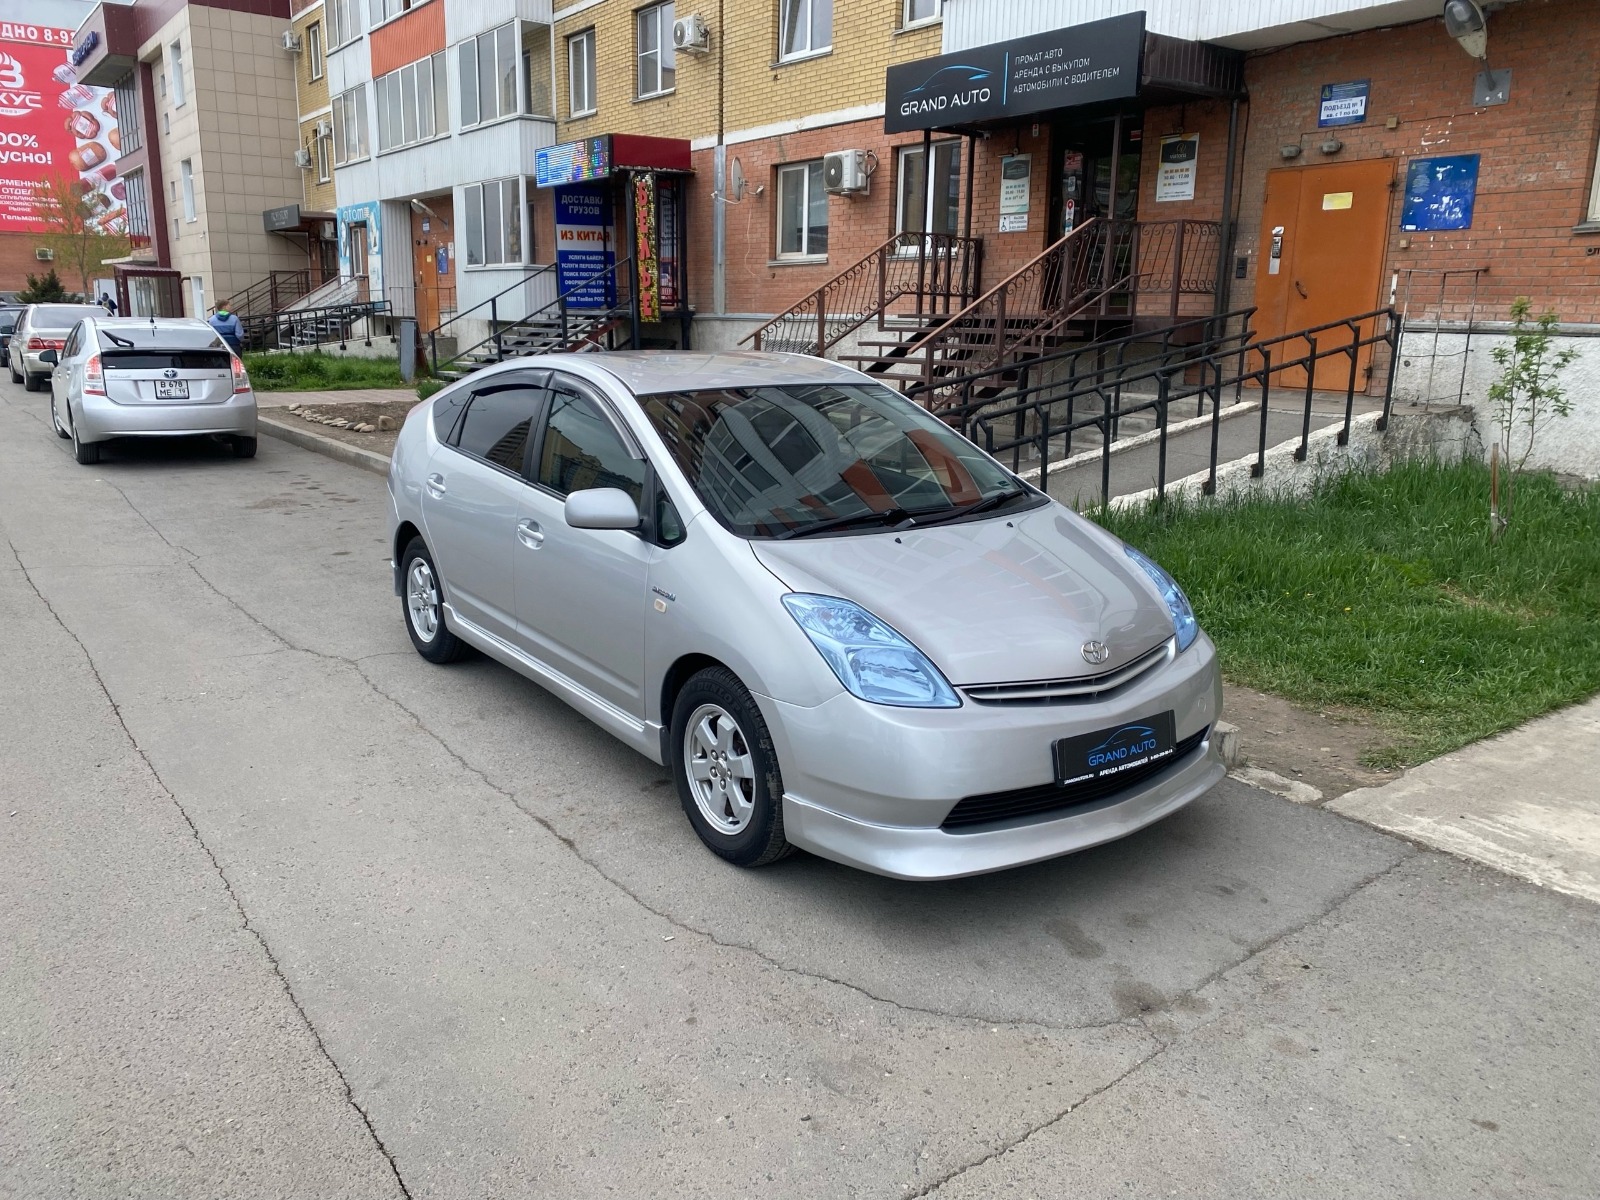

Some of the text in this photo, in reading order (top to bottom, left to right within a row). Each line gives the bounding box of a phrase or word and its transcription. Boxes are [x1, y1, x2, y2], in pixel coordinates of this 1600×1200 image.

[1014, 48, 1063, 65] ПРОКАТ АВТО
[1014, 57, 1091, 79] АРЕНДА С ВЫКУПОМ
[1013, 67, 1121, 93] АВТОМОБИЛИ С ВОДИТЕЛЕМ
[900, 87, 991, 116] GRAND AUTO
[1360, 99, 1364, 107] 1
[568, 206, 600, 215] ГРУЗОВ
[561, 230, 574, 241] ИЗ
[637, 181, 653, 317] БЕЛЬЕ
[697, 681, 742, 714] DUNLOP
[1088, 748, 1128, 767] GRAND
[1130, 739, 1157, 757] AUTO
